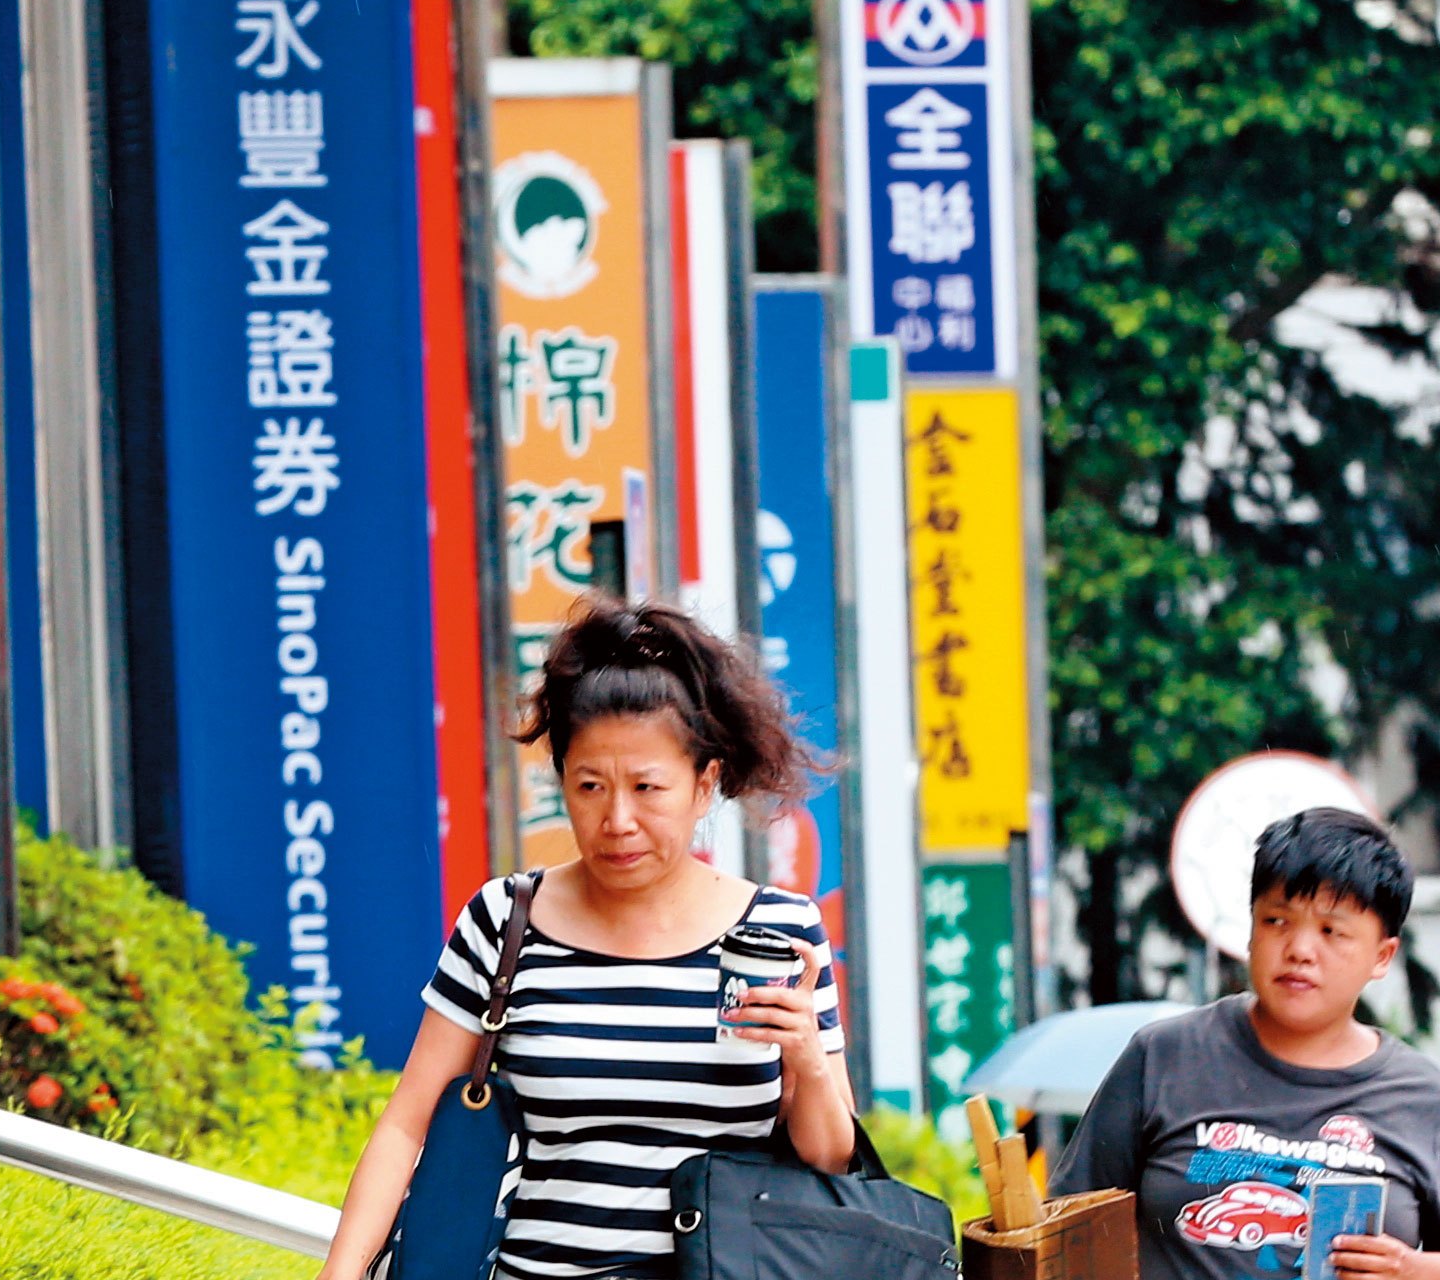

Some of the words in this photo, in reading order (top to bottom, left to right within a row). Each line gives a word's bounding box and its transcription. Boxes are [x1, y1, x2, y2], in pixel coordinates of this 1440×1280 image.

[883, 86, 976, 265] 全聯
[274, 535, 329, 787] SinoPac
[906, 407, 972, 779] 金石堂書店
